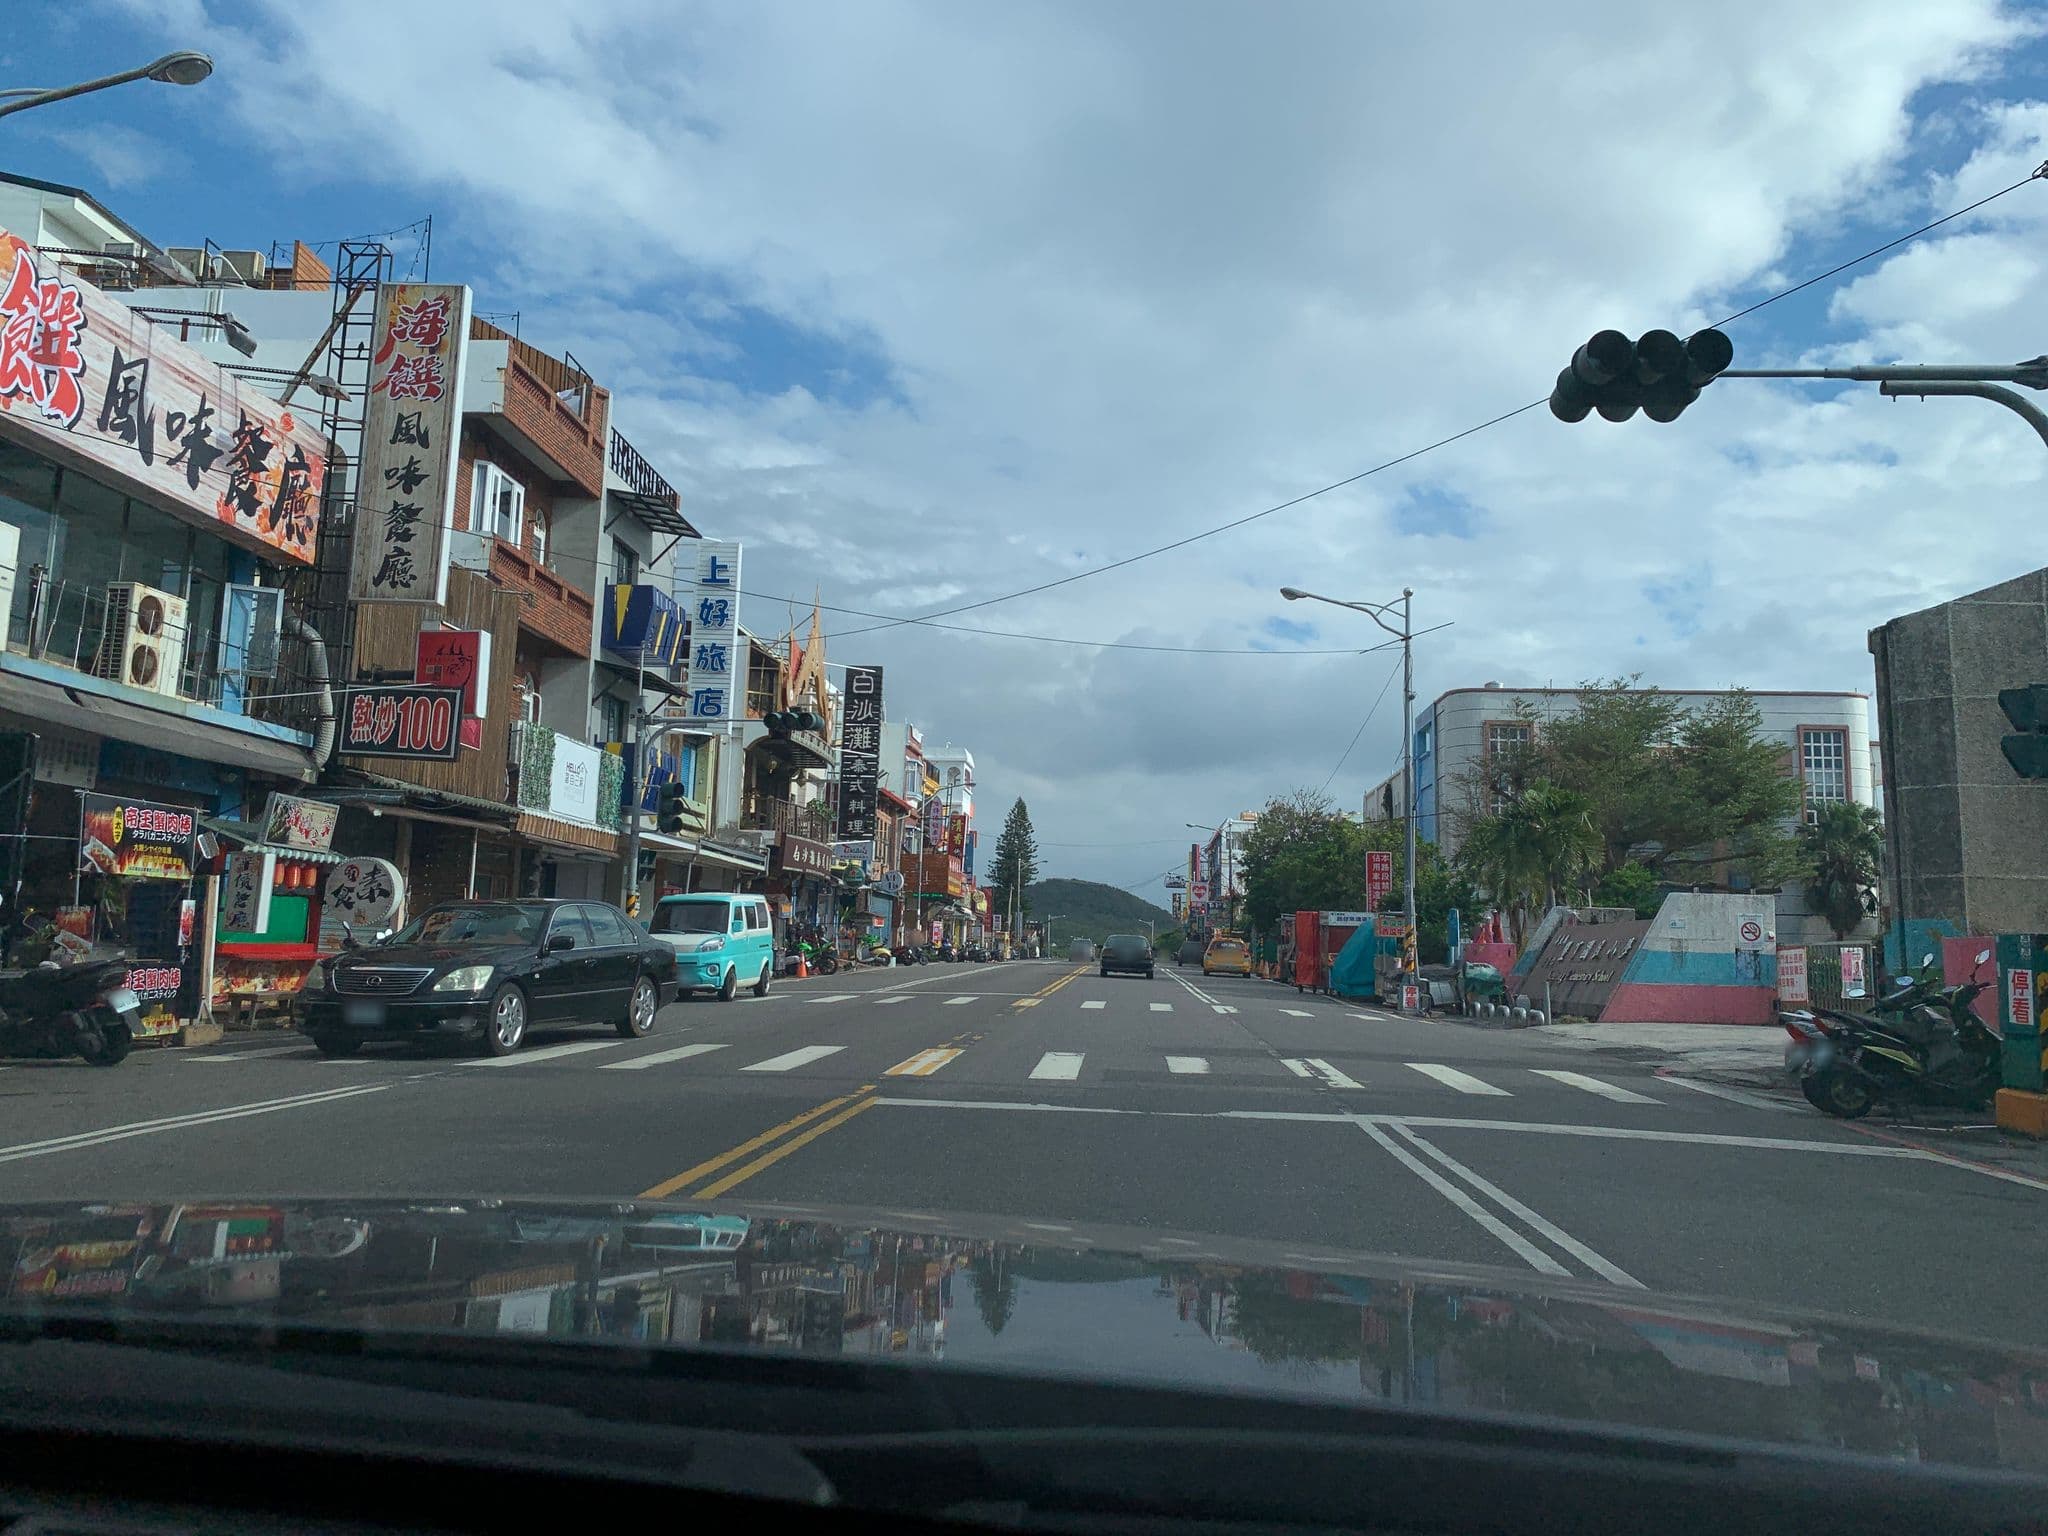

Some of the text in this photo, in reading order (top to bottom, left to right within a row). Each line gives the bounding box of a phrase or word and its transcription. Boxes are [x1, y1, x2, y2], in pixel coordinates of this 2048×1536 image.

[692, 554, 731, 718] 上好旅店
[349, 693, 452, 752] 熱炒100
[847, 671, 875, 835] 白沙灘泰式料理
[124, 806, 193, 836] 帝王蟹肉棒
